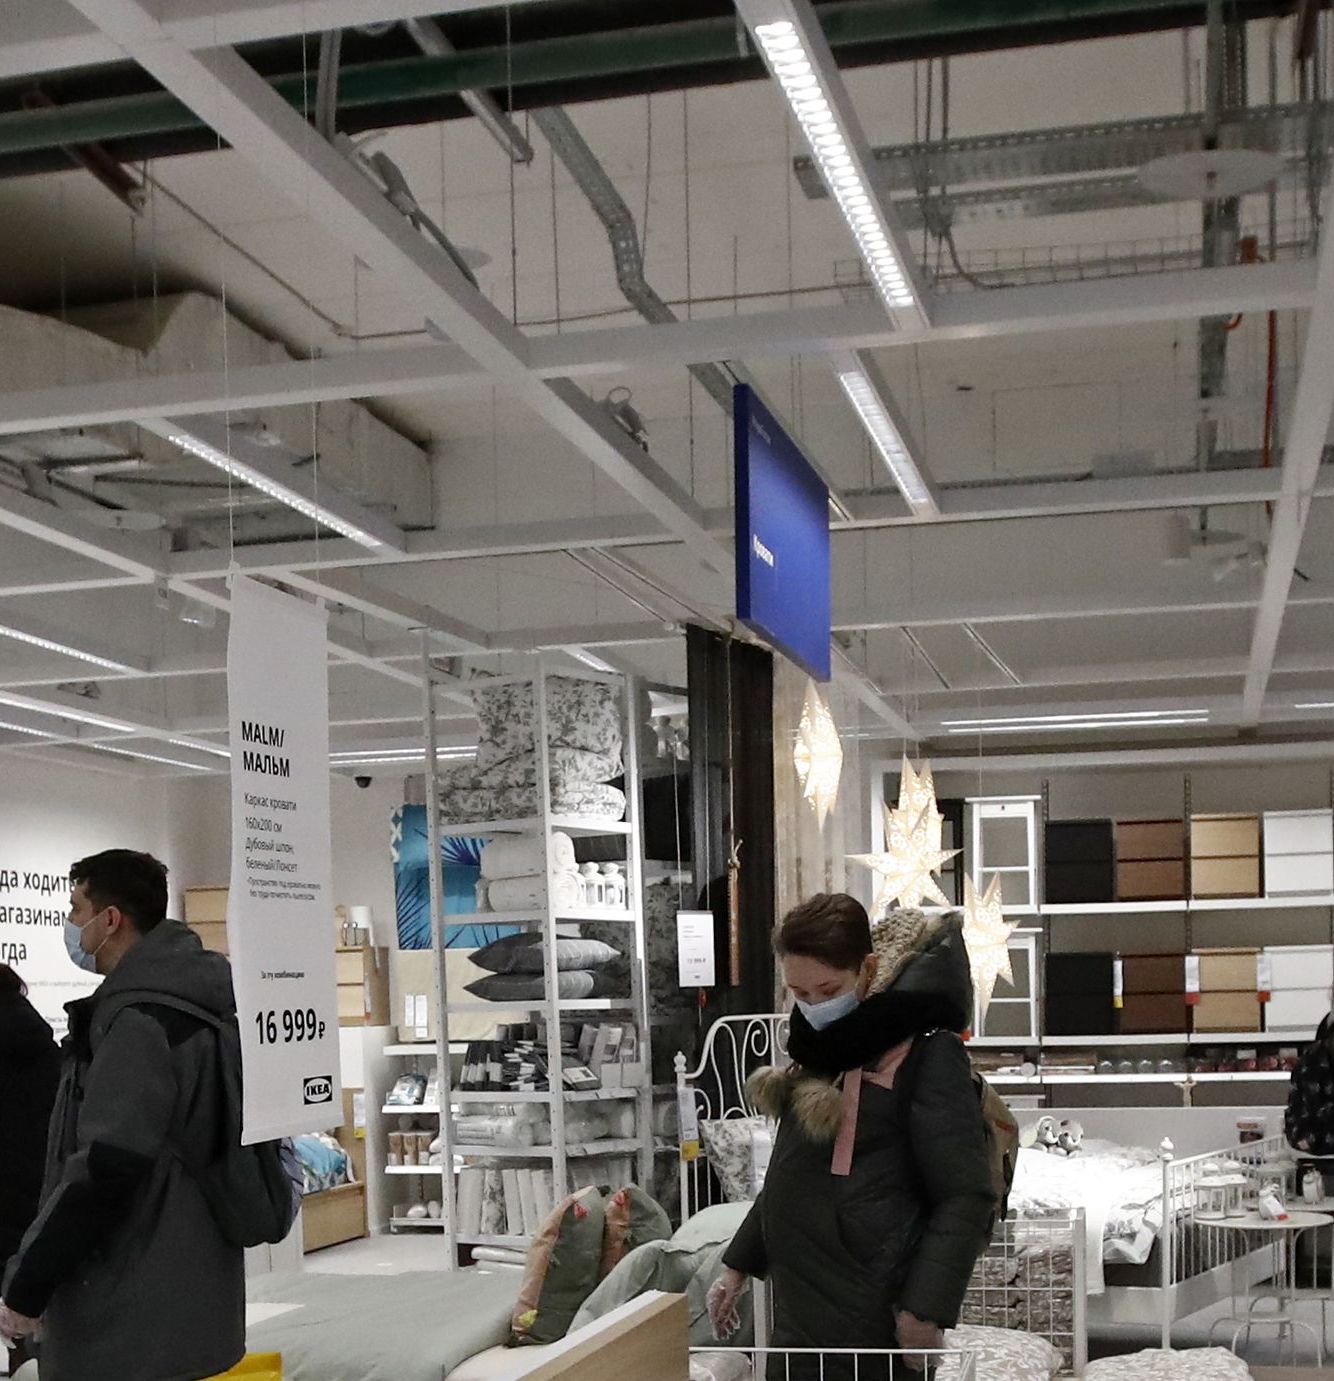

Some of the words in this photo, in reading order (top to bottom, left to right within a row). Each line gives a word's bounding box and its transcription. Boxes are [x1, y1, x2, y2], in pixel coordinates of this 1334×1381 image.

[242, 720, 285, 748] MALM/
[243, 750, 290, 778] МАЛЬМ
[244, 792, 269, 809] Каркас
[270, 798, 296, 811] кровати
[245, 837, 274, 852] Дубовый
[255, 1010, 278, 1045] 16
